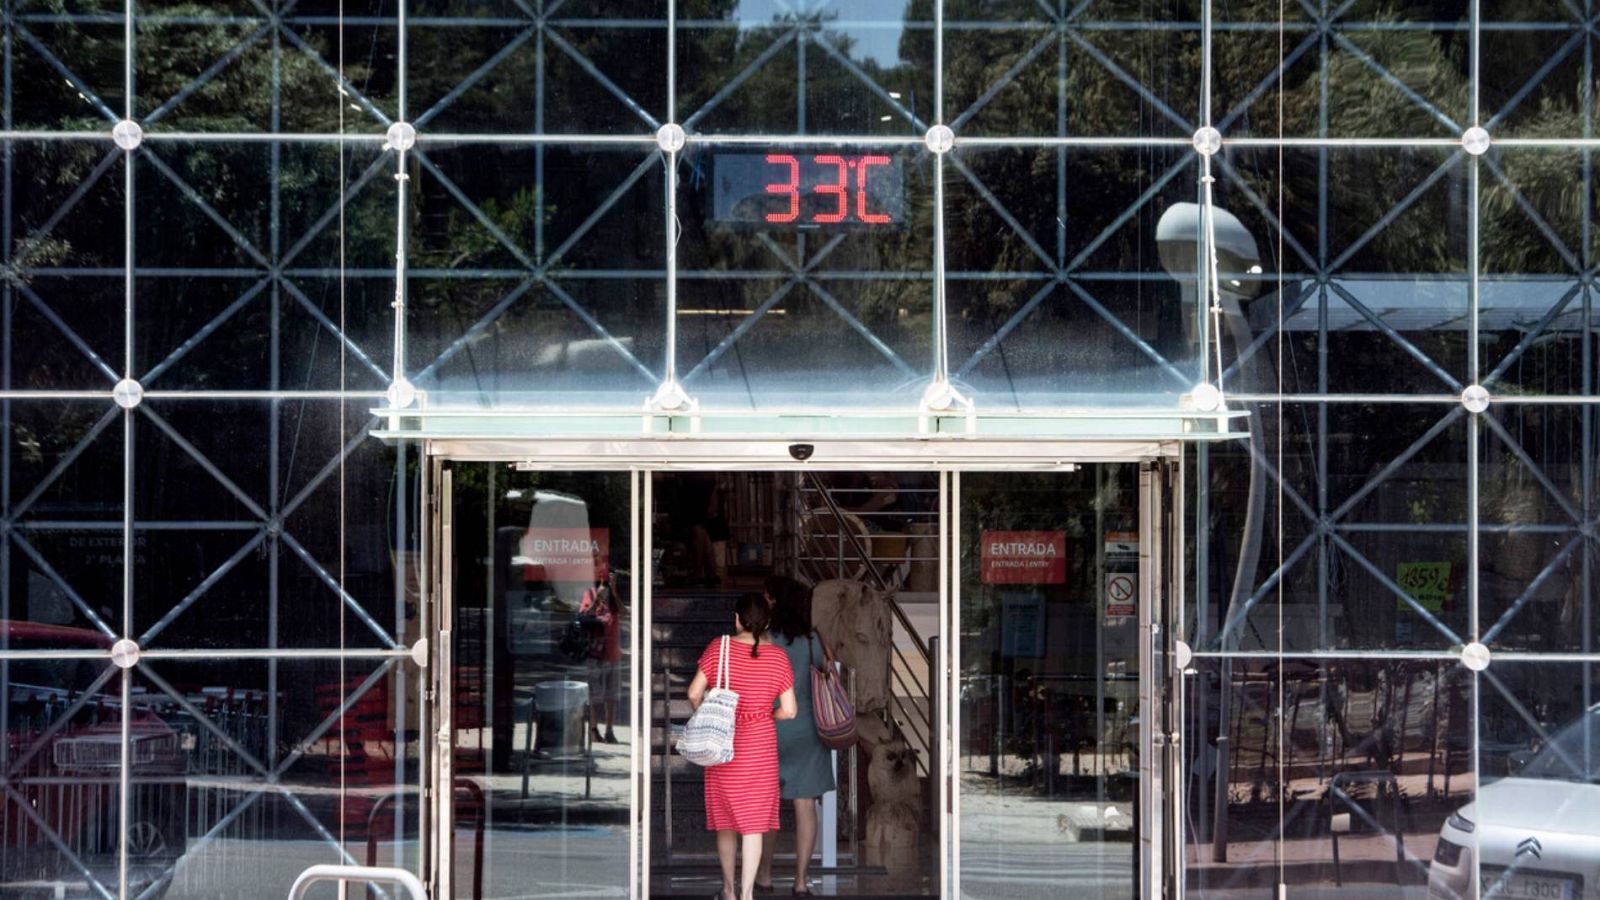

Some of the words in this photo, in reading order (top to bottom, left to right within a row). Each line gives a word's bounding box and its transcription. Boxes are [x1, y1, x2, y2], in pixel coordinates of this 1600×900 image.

[88, 537, 147, 547] EXTERR
[534, 539, 599, 552] ENTRADA
[991, 543, 1056, 555] ENTRADA
[99, 555, 146, 564] PLAA
[991, 561, 1025, 569] ENTRADA
